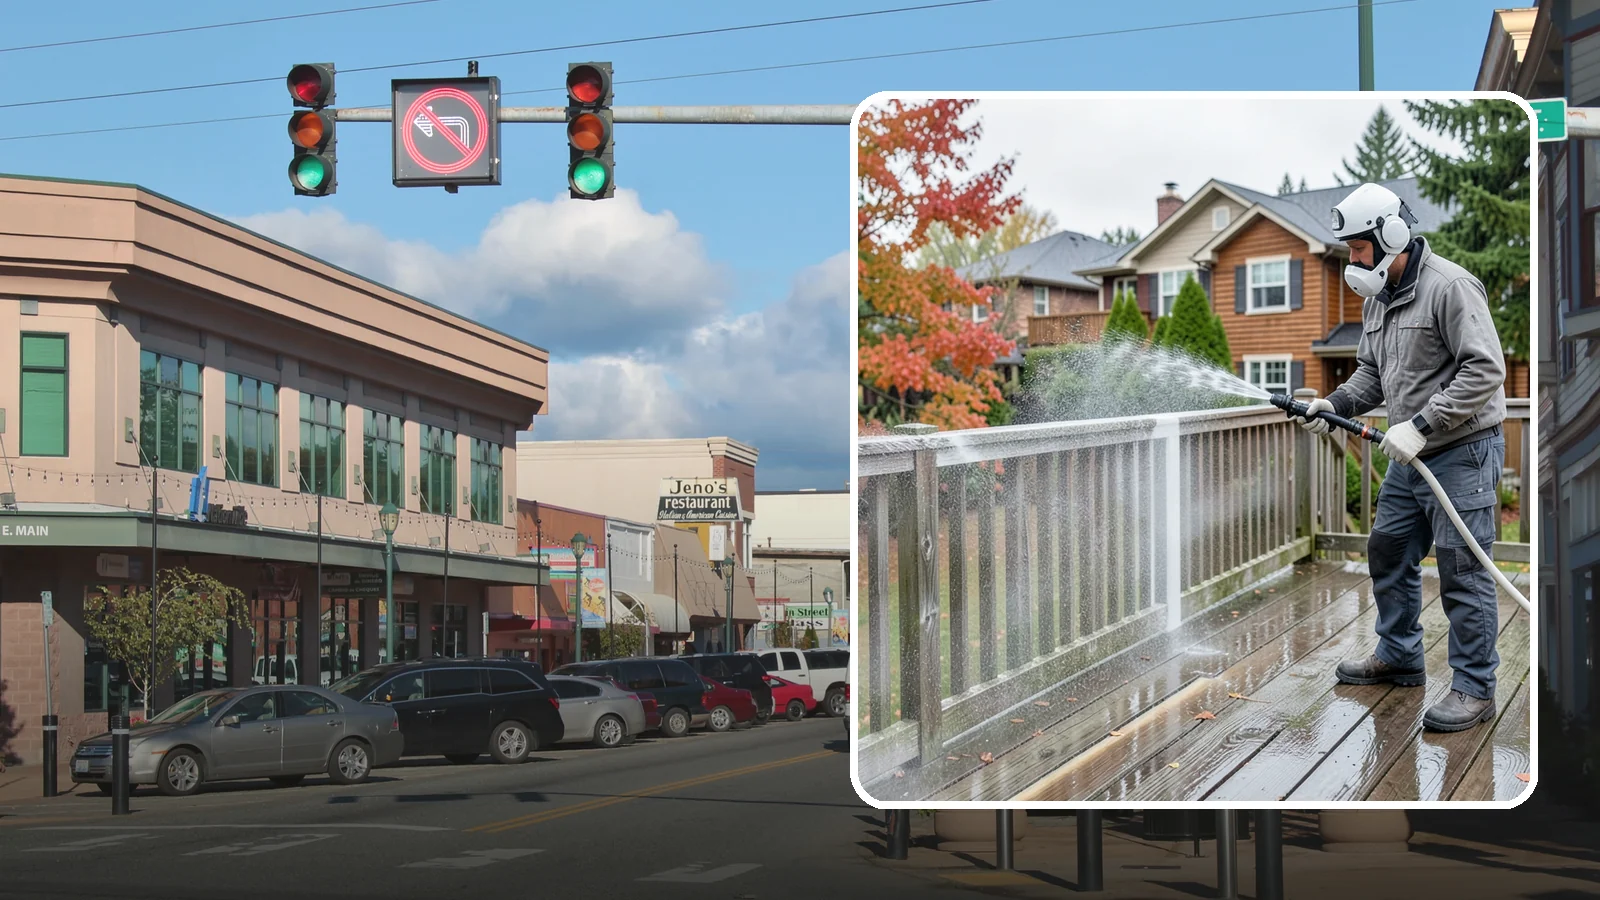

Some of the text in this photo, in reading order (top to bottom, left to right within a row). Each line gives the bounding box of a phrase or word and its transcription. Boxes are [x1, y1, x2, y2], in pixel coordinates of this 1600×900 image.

[670, 480, 727, 494] Jeno's
[665, 496, 731, 509] restaurant
[686, 509, 714, 519] American
[715, 509, 737, 519] Cuisine
[2, 525, 48, 536] E. MAIN
[797, 607, 828, 617] Street
